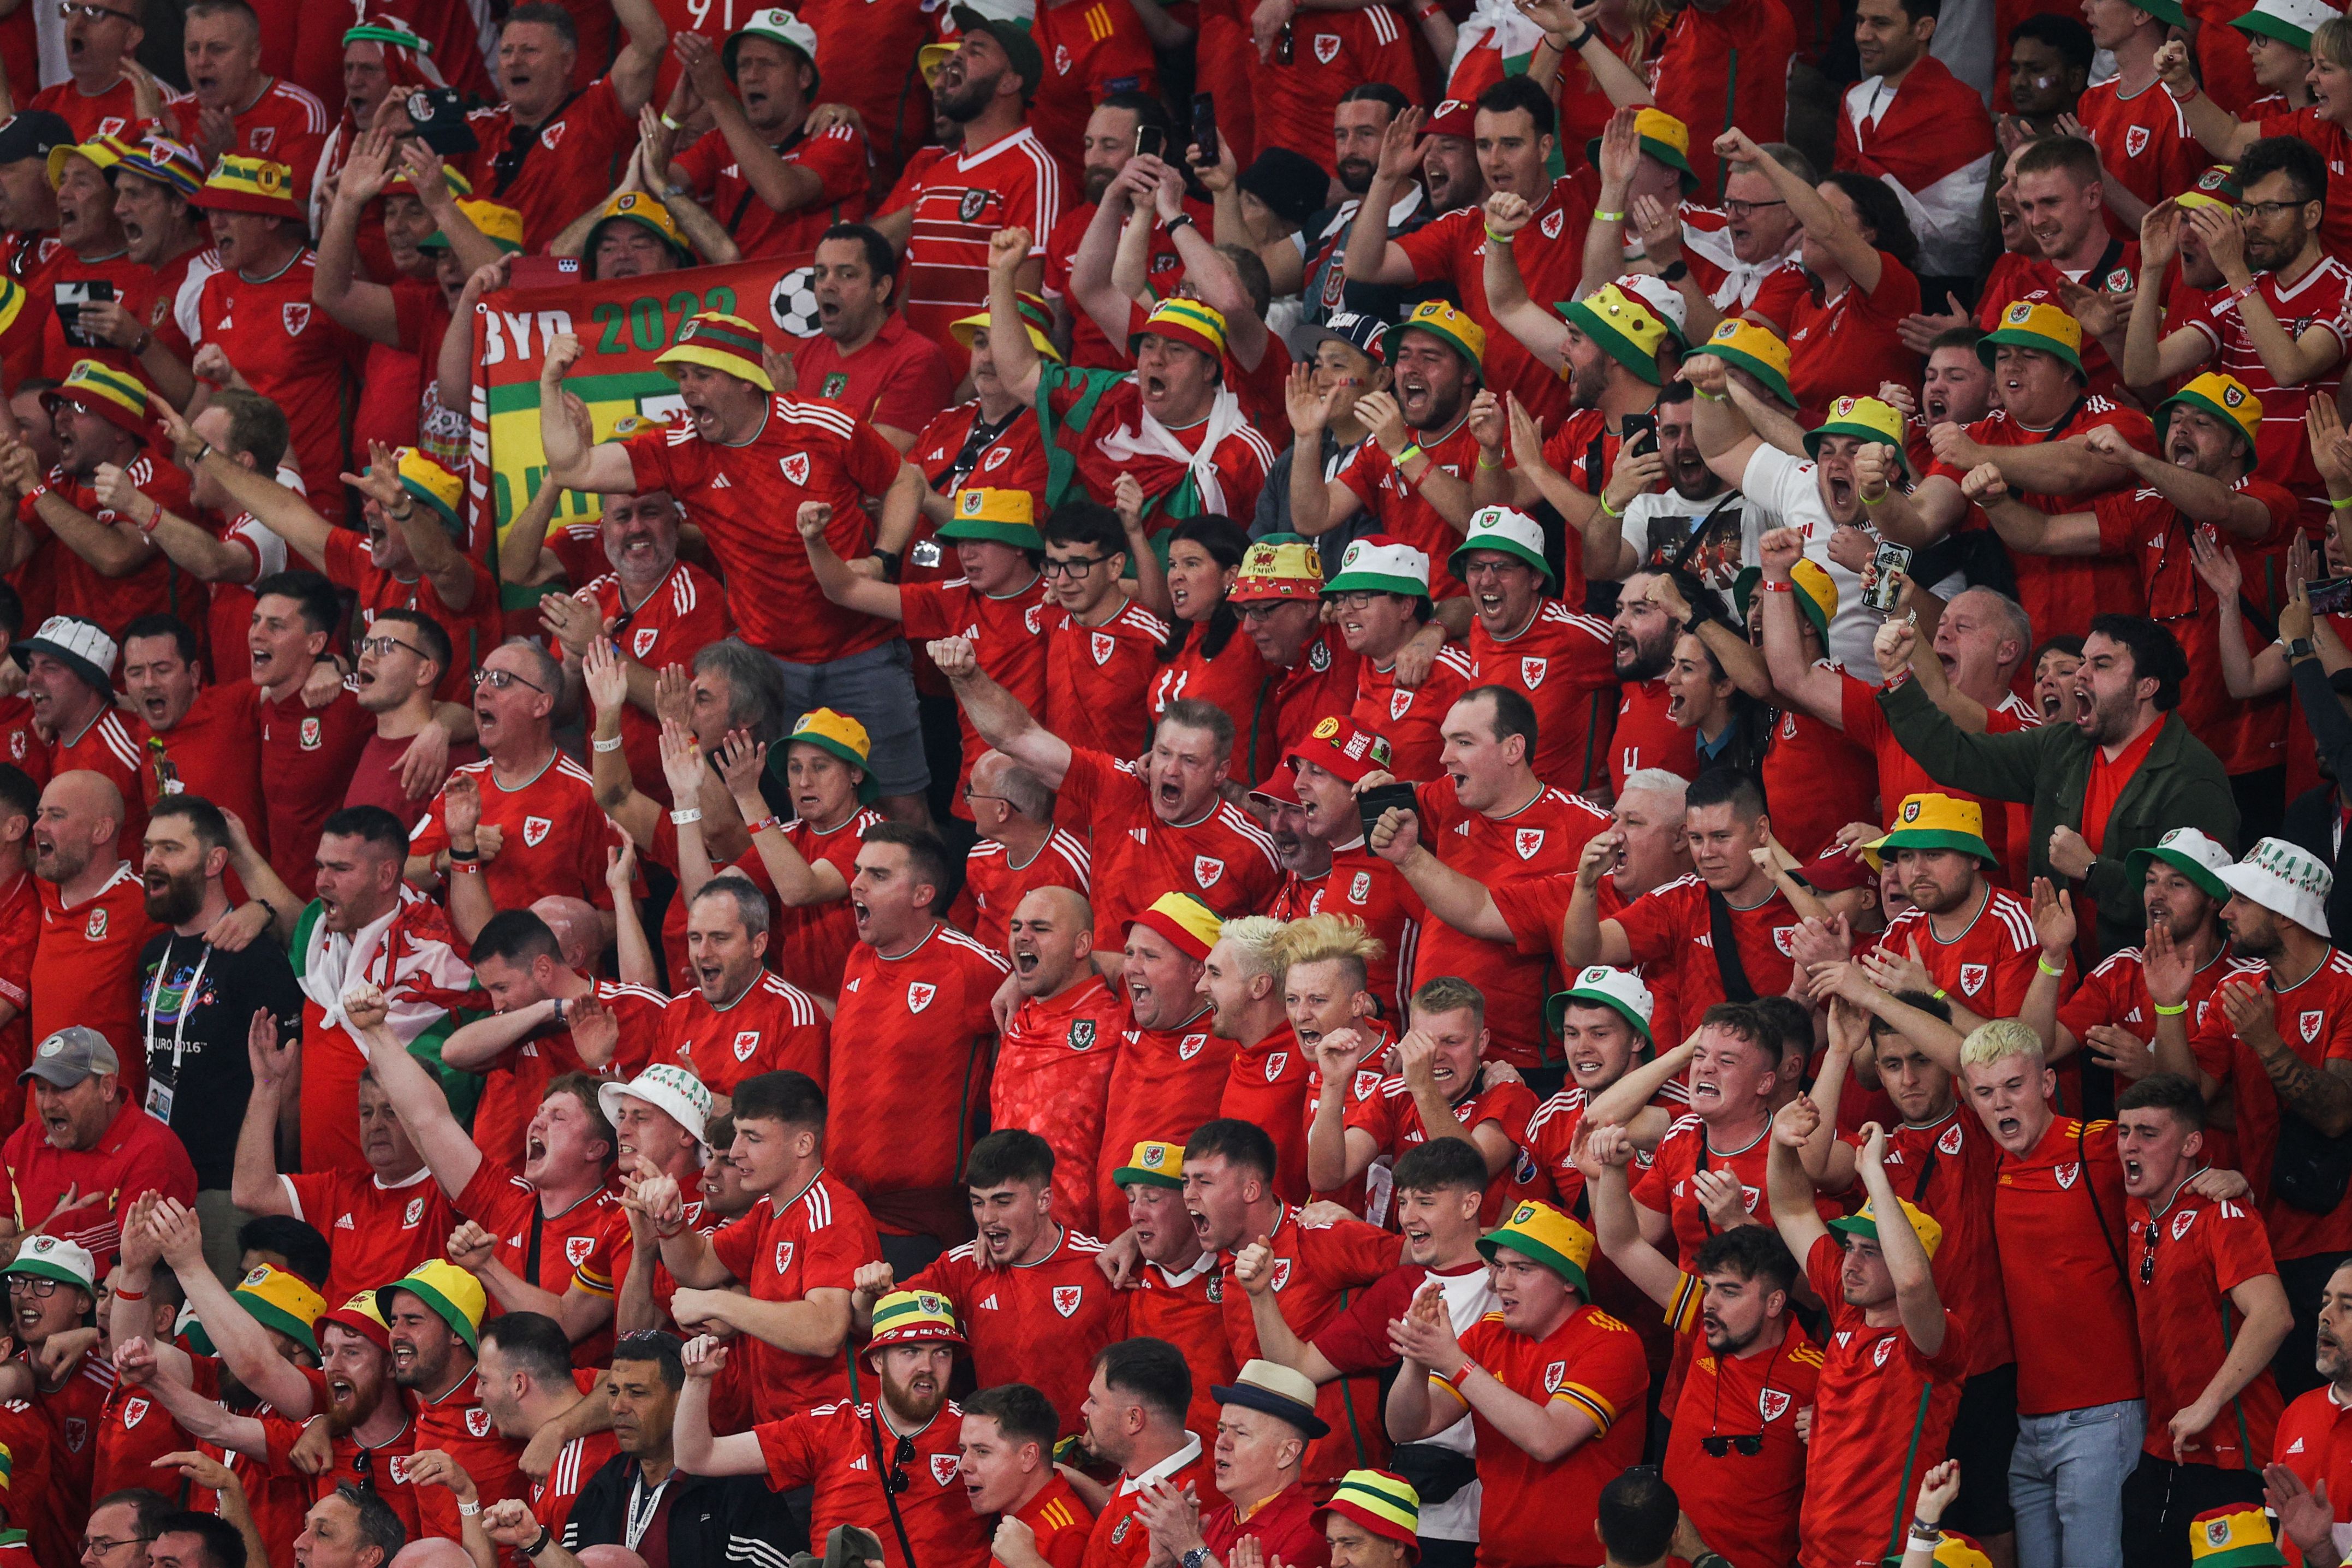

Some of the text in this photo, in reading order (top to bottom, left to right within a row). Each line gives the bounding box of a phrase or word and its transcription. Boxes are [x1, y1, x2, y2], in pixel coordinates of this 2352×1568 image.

[687, 0, 733, 30] 91
[1254, 545, 1278, 554] WALES
[1248, 566, 1276, 574] CYMRU
[1155, 669, 1187, 712] 11
[1345, 740, 1364, 757] ME
[1351, 736, 1367, 750] TAKE
[1343, 748, 1360, 762] HOME
[152, 1036, 173, 1051] URO
[1696, 1359, 1717, 1376] adidas
